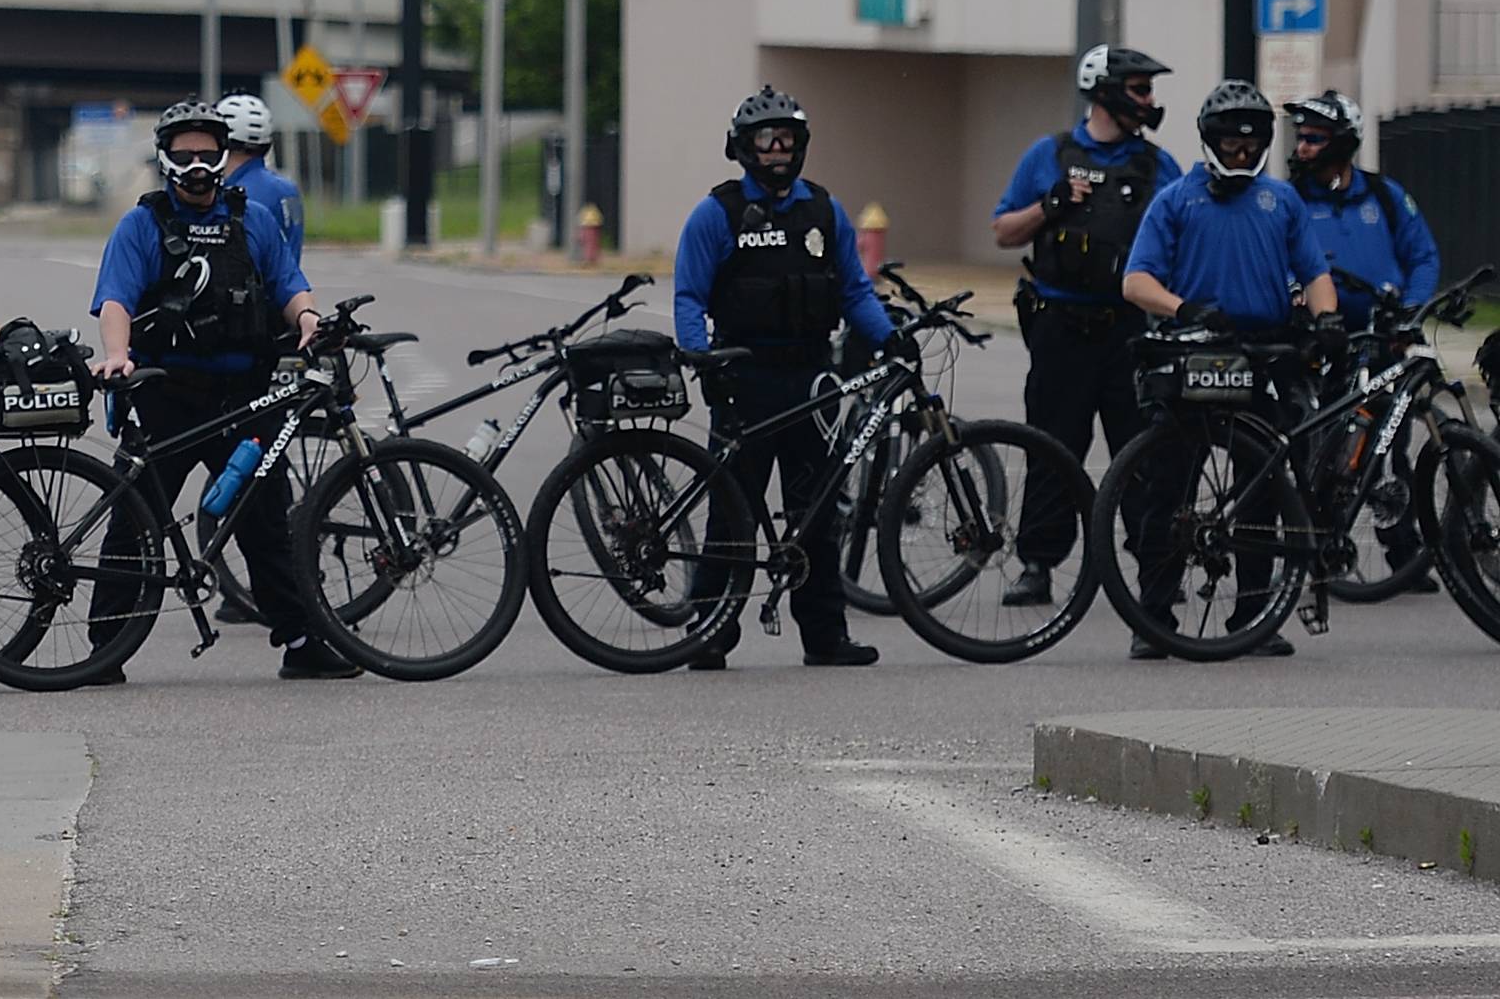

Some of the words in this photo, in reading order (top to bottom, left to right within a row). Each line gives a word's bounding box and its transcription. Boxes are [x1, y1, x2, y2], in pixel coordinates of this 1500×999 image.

[189, 224, 221, 236] POLICE
[738, 230, 787, 248] POLICE
[841, 365, 890, 395] POLICE
[1188, 371, 1253, 388] POLICE
[4, 392, 81, 412] POLICE
[249, 383, 300, 412] POLICE
[843, 400, 890, 465] volcanic
[254, 414, 301, 477] volcanic
